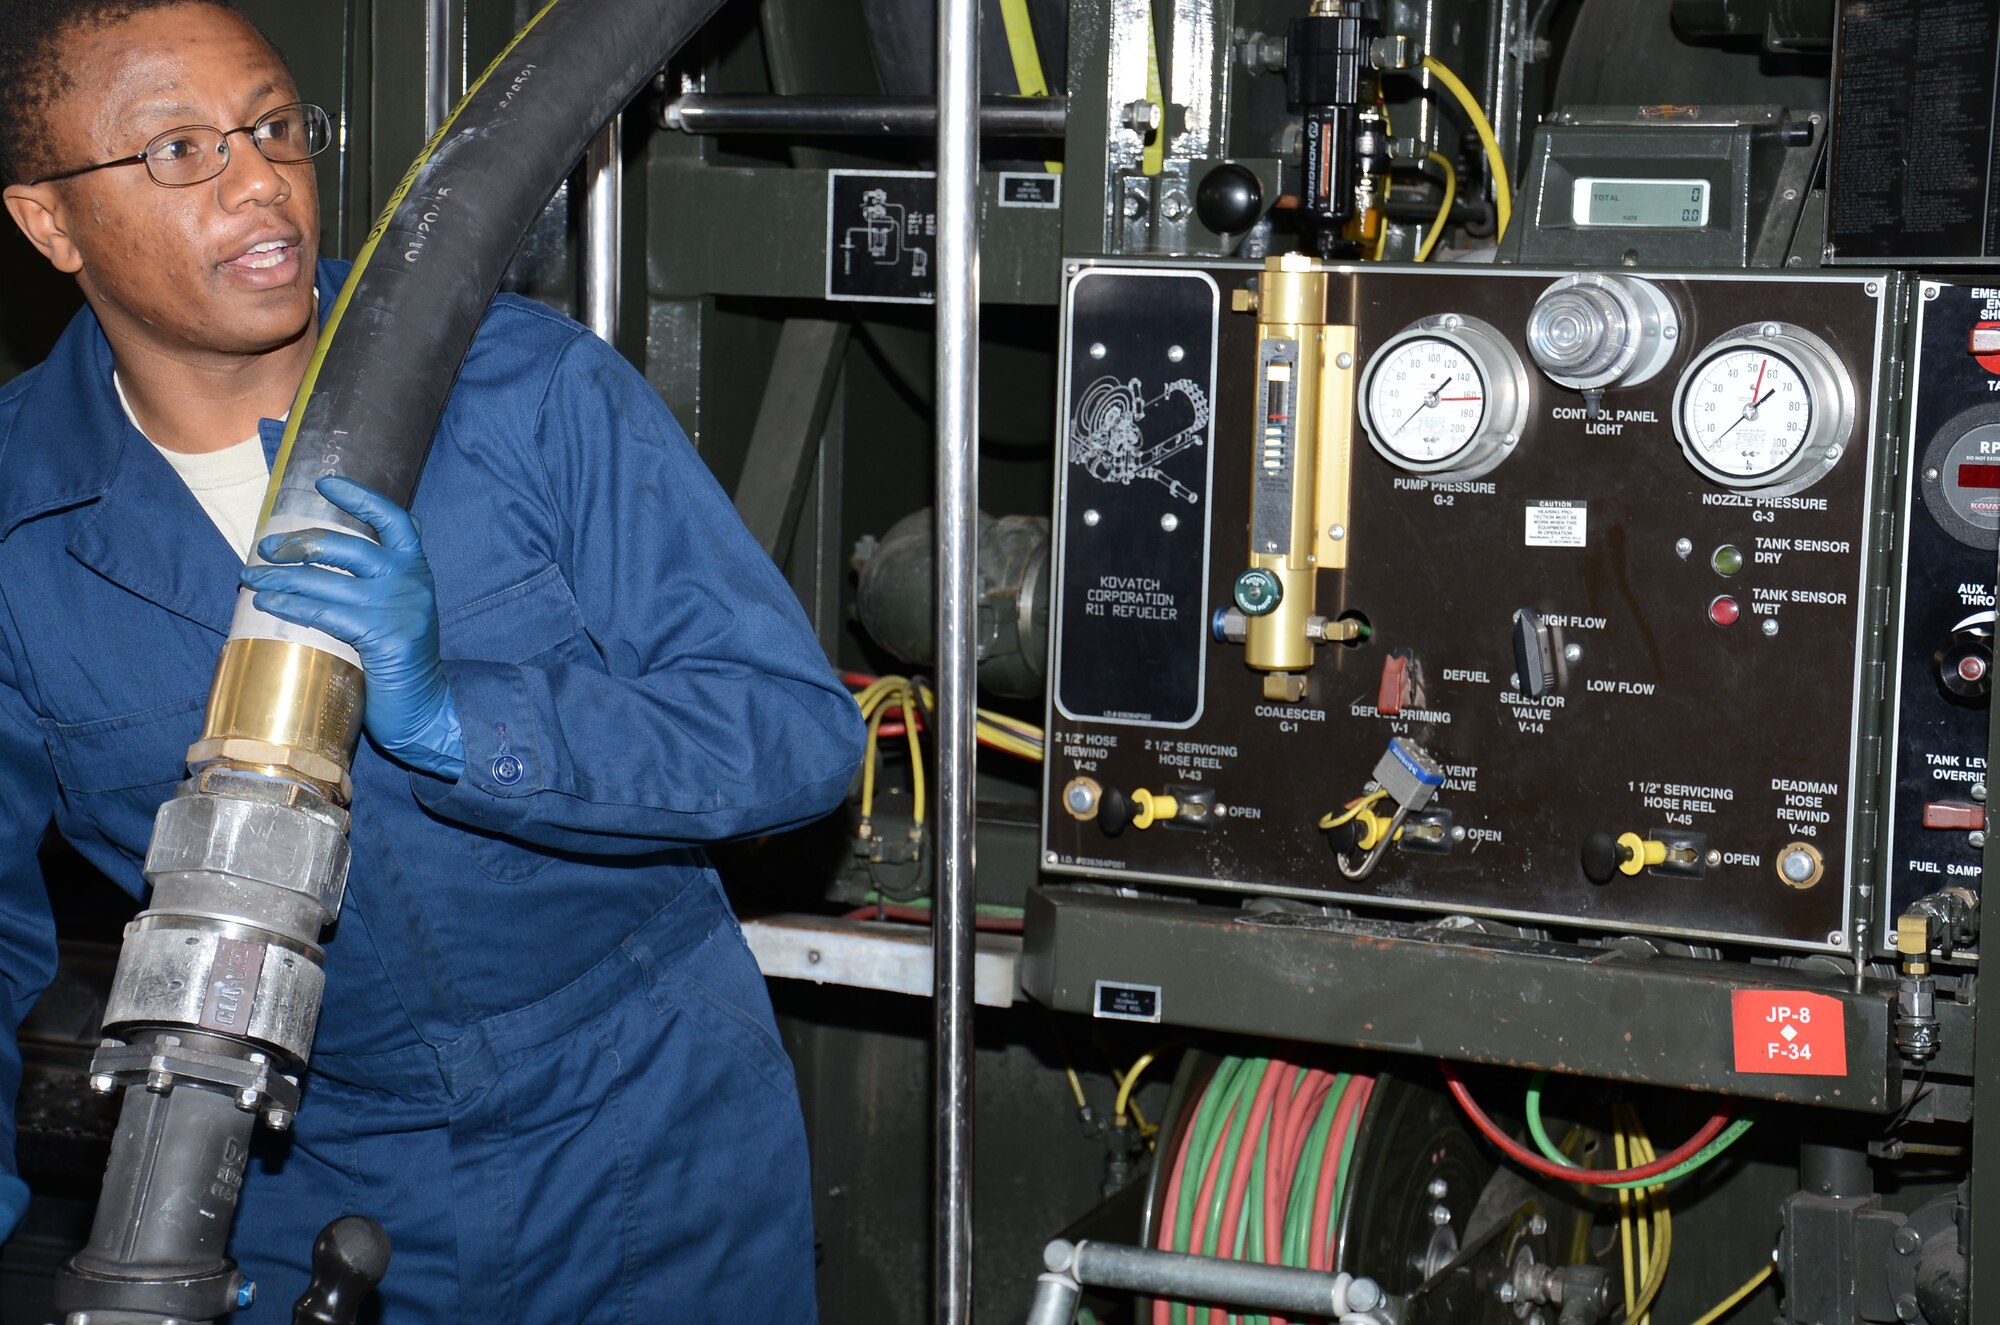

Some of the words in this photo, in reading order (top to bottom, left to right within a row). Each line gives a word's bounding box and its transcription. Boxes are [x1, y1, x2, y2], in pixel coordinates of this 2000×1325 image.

[1307, 140, 1317, 210] NORGREN
[1594, 194, 1619, 202] TOTAL
[1691, 187, 1700, 202] 0
[1682, 208, 1700, 222] 0.0
[1971, 287, 2000, 299] EME
[1980, 309, 2000, 320] SH
[1410, 359, 1421, 369] 80
[1428, 353, 1441, 363] 100
[1444, 359, 1457, 369] 120
[1727, 369, 1739, 379] 40
[1747, 363, 1759, 374] 50
[1766, 369, 1778, 380] 60
[1396, 371, 1406, 381] 60
[1457, 373, 1470, 382] 140
[1712, 383, 1723, 393] 30
[1782, 382, 1793, 392] 70
[1389, 389, 1399, 399] 40
[1463, 390, 1477, 399] 160
[1391, 408, 1402, 418] 20
[1460, 408, 1474, 418] 180
[1704, 402, 1716, 412] 20
[1788, 402, 1800, 412] 80
[1552, 407, 1614, 421] CONTOL
[1616, 409, 1659, 423] PANEL
[1450, 423, 1466, 433] 200
[1585, 423, 1624, 436] LIGHT
[1706, 423, 1716, 433] 10
[1786, 421, 1798, 432] 90
[1773, 437, 1788, 448] 100
[1394, 478, 1429, 492] PUMP
[1430, 482, 1496, 494] PRESSURE
[1433, 494, 1455, 507] G-2
[1539, 500, 1572, 508] CAUTION
[1702, 493, 1753, 507] NOZZLE
[1757, 497, 1828, 511] PRESSURE
[1752, 510, 1775, 523] G-3
[1755, 537, 1791, 550] TANK
[1794, 539, 1850, 553] SENSOR
[1754, 551, 1783, 564] DRY
[1100, 576, 1161, 591] KOVATCH
[1957, 583, 1988, 595] AUX.
[1087, 588, 1175, 606] CORPORATION
[1752, 588, 1789, 601] TANK
[1791, 590, 1847, 605] SENSOR
[1960, 594, 1996, 607] THRO
[1085, 602, 1106, 617] R11
[1112, 604, 1178, 621] REFUELER
[1752, 603, 1781, 615] WET
[1537, 613, 1568, 627] HIGH
[1570, 616, 1607, 629] FLOW
[1443, 668, 1490, 683] DEFUEL
[1587, 679, 1616, 693] LOW
[1618, 682, 1655, 696] FLOW
[1254, 705, 1326, 722] COALESCER
[1399, 708, 1452, 724] PRIMING
[1512, 707, 1551, 721] VALVE
[1279, 721, 1298, 733] G-1
[1391, 721, 1409, 734] V-1
[1518, 721, 1544, 734] V-14
[1055, 732, 1062, 743] 2
[1064, 733, 1085, 745] 1/2"
[1086, 735, 1118, 747] HOSE
[1063, 746, 1108, 760] REWIND
[1144, 740, 1152, 750] 2
[1154, 740, 1174, 752] 1/2"
[1176, 742, 1238, 757] SERVICING
[1073, 759, 1097, 772] V-42
[1159, 754, 1191, 767] HOSE
[1193, 756, 1222, 770] REEL
[1925, 753, 1960, 767] TANK
[1178, 769, 1202, 782] V-43
[1446, 765, 1478, 778] VENT
[1628, 781, 1634, 792] 1
[1638, 782, 1662, 795] 1/2"
[1663, 783, 1734, 801] SERVICING
[1771, 778, 1838, 796] DEADMAN
[1643, 797, 1681, 810] HOSE
[1683, 800, 1716, 814] REEL
[1785, 794, 1823, 809] HOSE
[1228, 806, 1261, 819] OPEN
[1665, 812, 1693, 826] V-45
[1776, 808, 1831, 824] REWIND
[1467, 828, 1502, 842] OPEN
[1788, 823, 1817, 837] V-46
[1723, 852, 1760, 867] OPEN
[1909, 860, 1941, 874] FUEL
[1946, 863, 1982, 878] SAMP
[1765, 1006, 1811, 1024] JP-8
[1767, 1042, 1812, 1060] F-34
